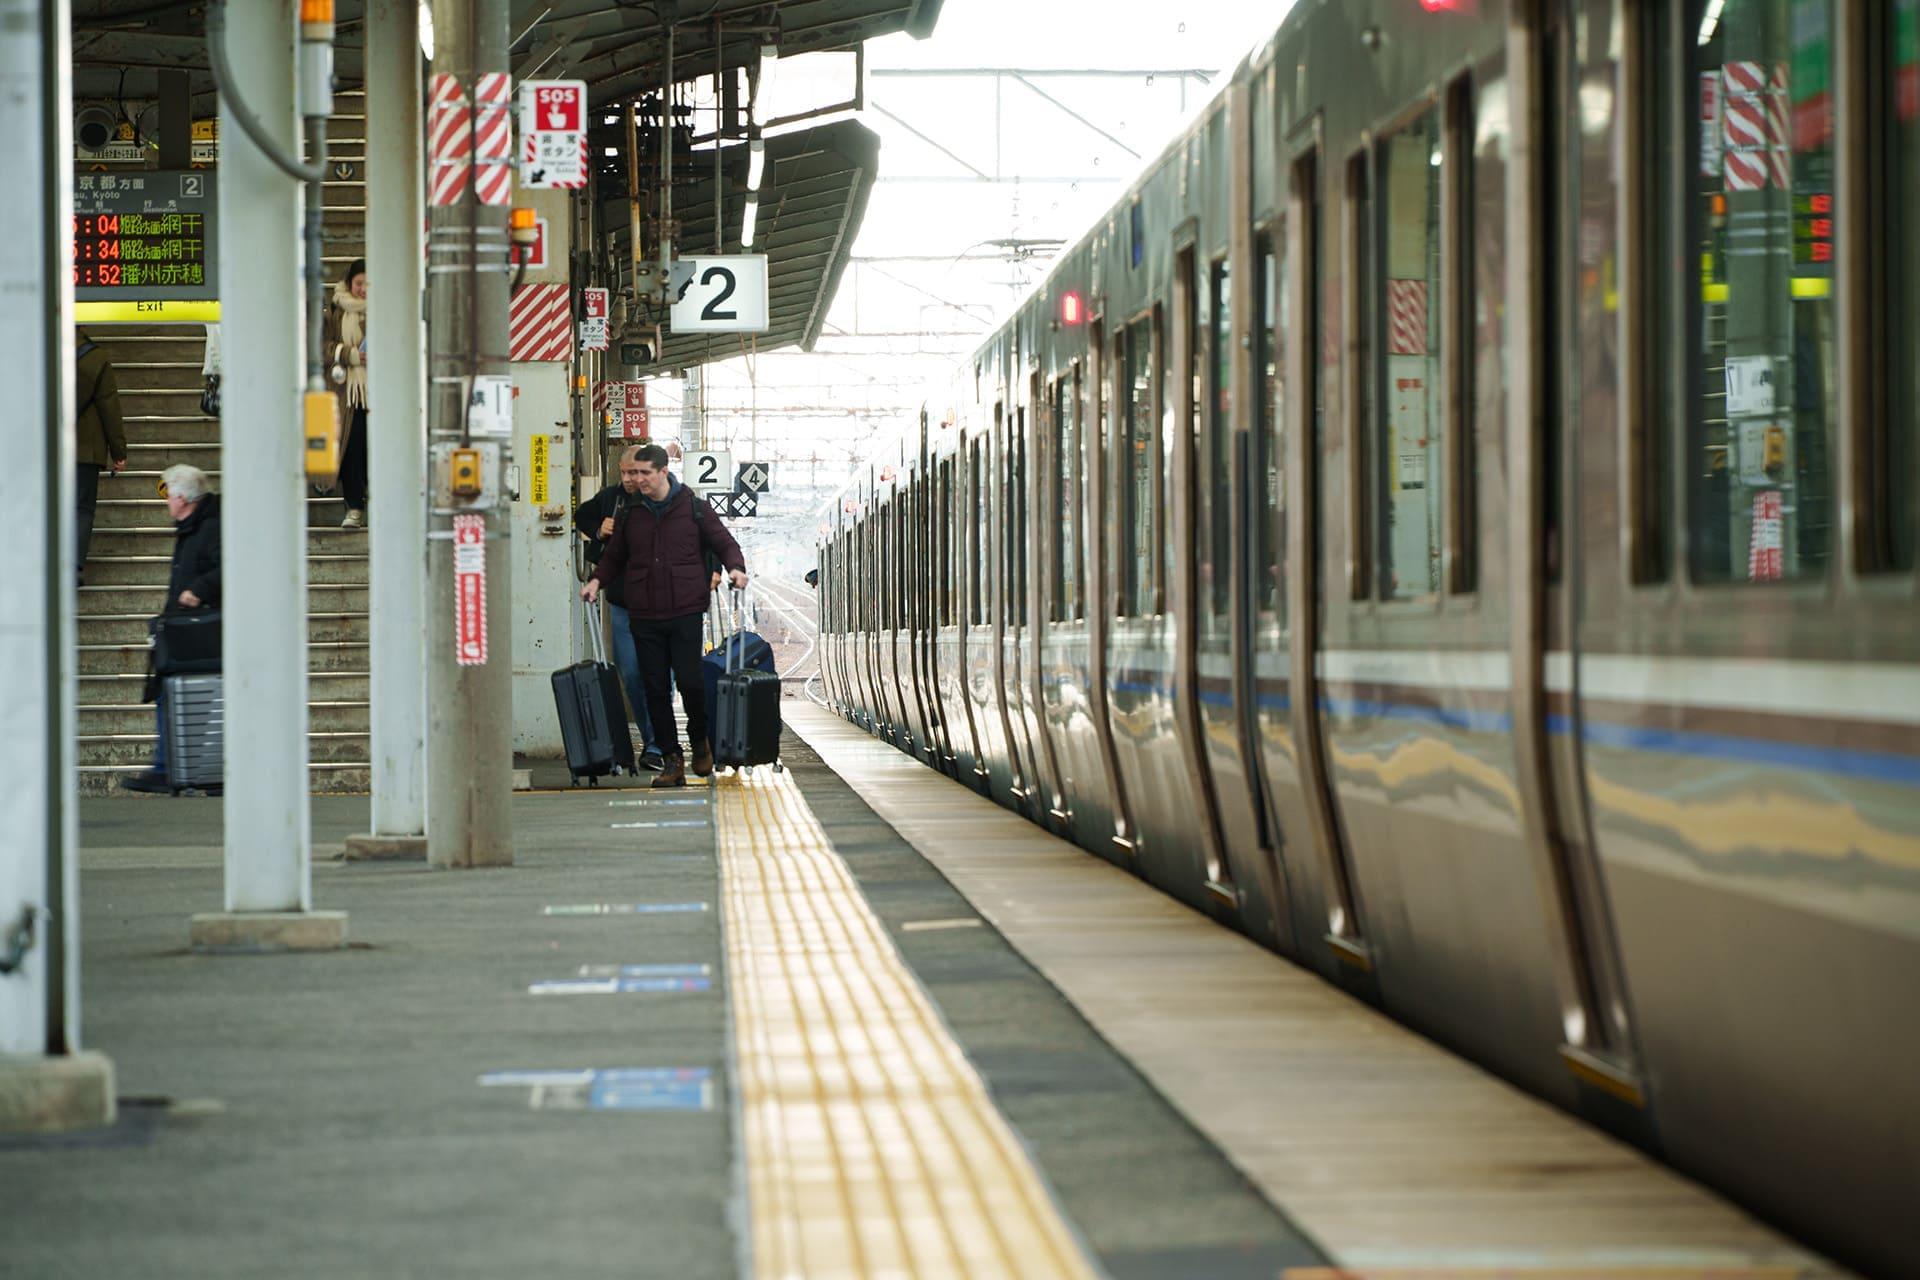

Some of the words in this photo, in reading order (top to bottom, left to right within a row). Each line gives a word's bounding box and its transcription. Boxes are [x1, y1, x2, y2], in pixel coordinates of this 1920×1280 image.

[540, 89, 575, 104] SOS
[79, 175, 144, 190] 京都方面
[185, 177, 198, 195] 2
[700, 266, 737, 321] 2
[137, 301, 163, 311] Exit
[626, 413, 646, 422] SOS
[698, 455, 718, 484] 2
[749, 470, 760, 486] 4
